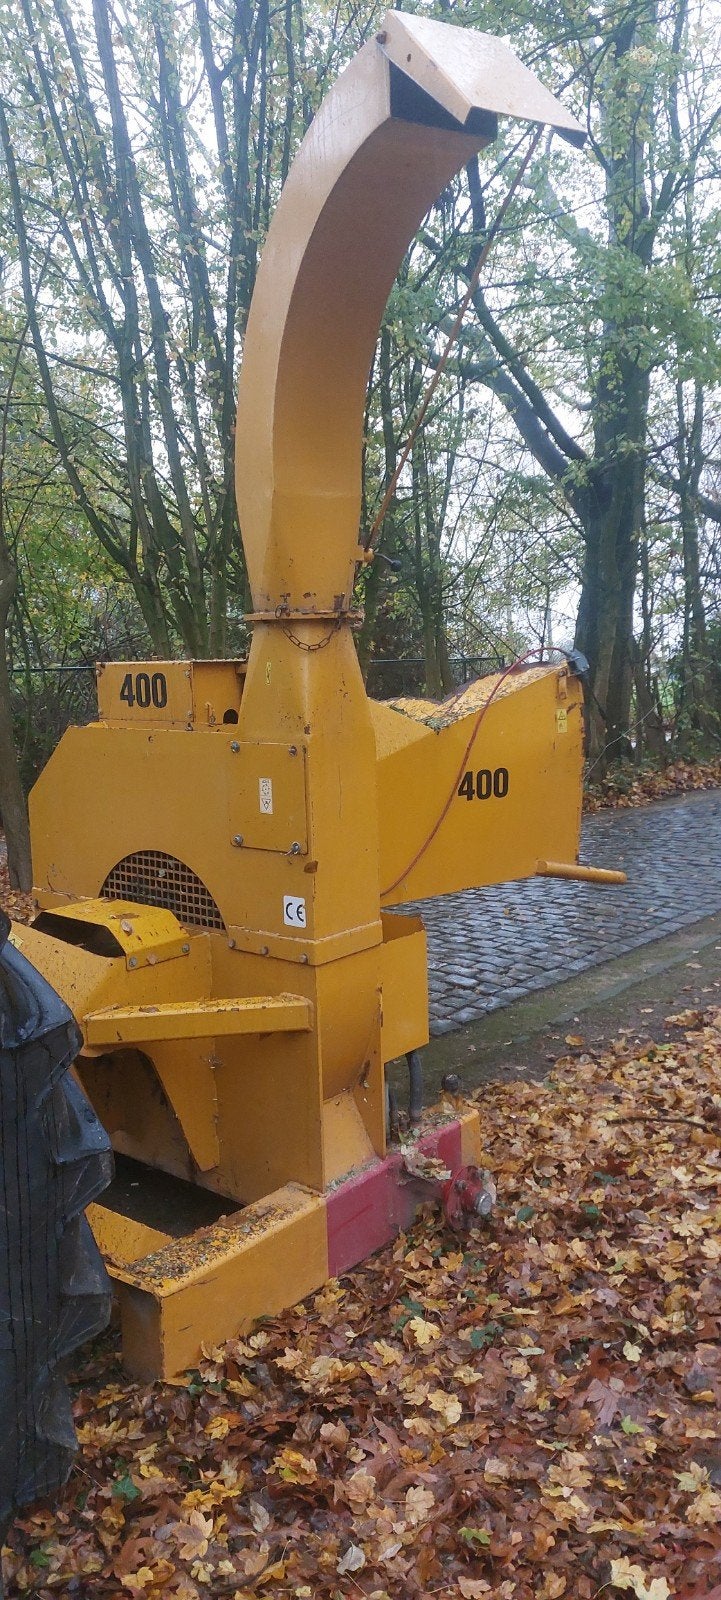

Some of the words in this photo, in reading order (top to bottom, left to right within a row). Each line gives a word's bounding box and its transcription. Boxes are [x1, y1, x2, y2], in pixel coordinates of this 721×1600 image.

[120, 673, 168, 708] 400
[458, 768, 509, 801] 400
[285, 902, 305, 922] CE
